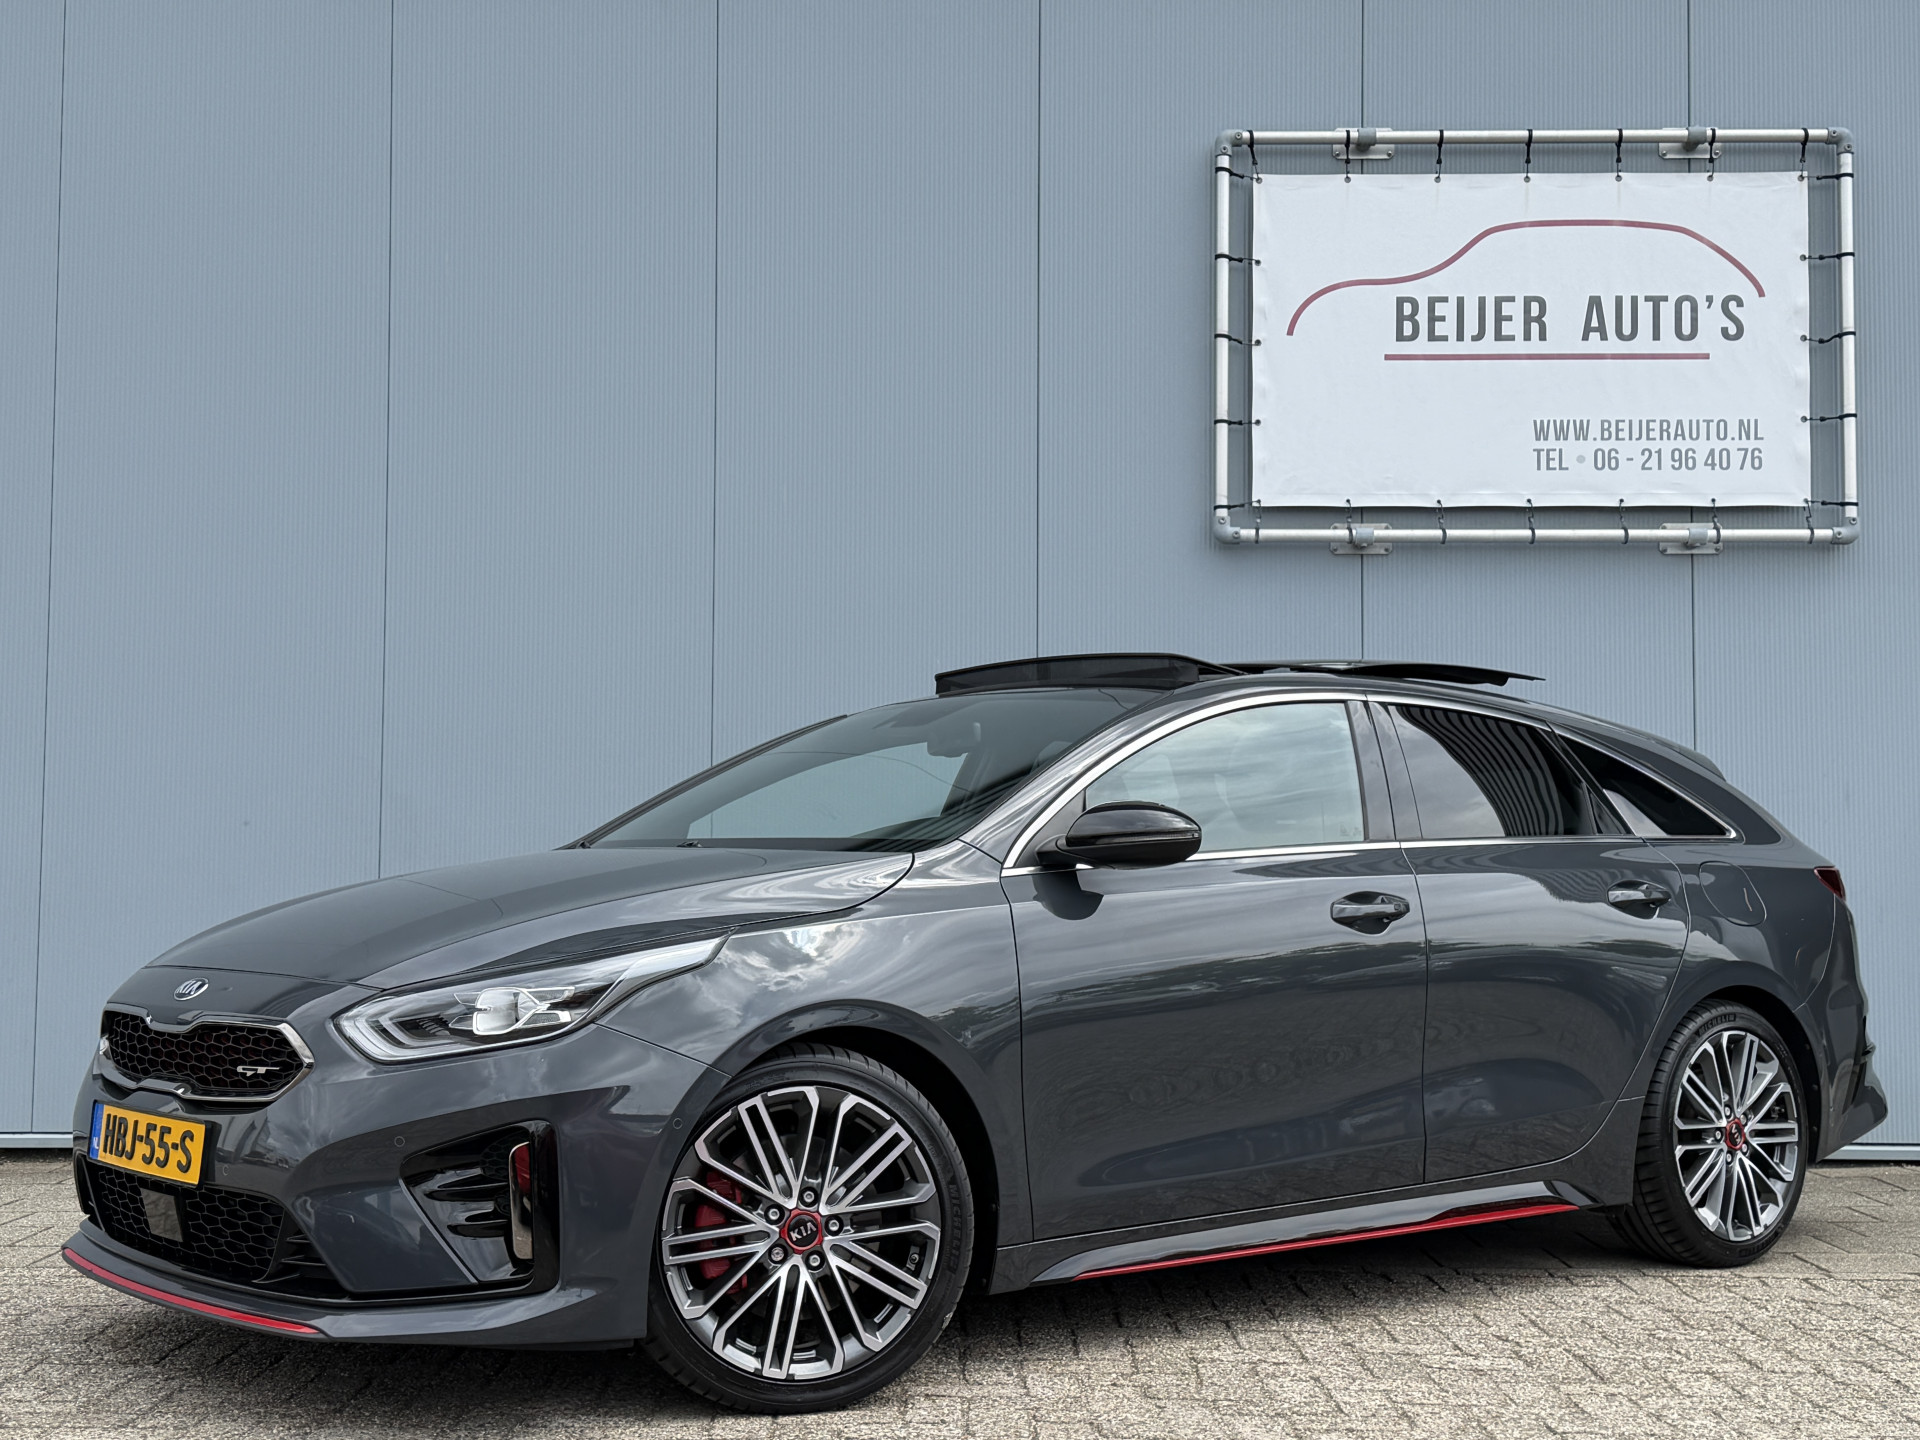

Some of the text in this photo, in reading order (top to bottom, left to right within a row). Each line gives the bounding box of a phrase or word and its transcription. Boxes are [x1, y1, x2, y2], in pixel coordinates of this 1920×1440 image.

[1395, 294, 1745, 342] BEIJER AUTO'S
[1532, 418, 1764, 442] WWW.BEIJERAUTO.NL
[1532, 448, 1569, 471] TEL
[1593, 447, 1620, 471] 06
[1640, 447, 1663, 471] 21
[1670, 447, 1697, 471] 96
[1703, 447, 1731, 471] 40
[1736, 447, 1763, 471] 76
[236, 1065, 280, 1077] GT
[103, 1113, 194, 1174] HBJ-55-S
[790, 1221, 818, 1242] KIA
